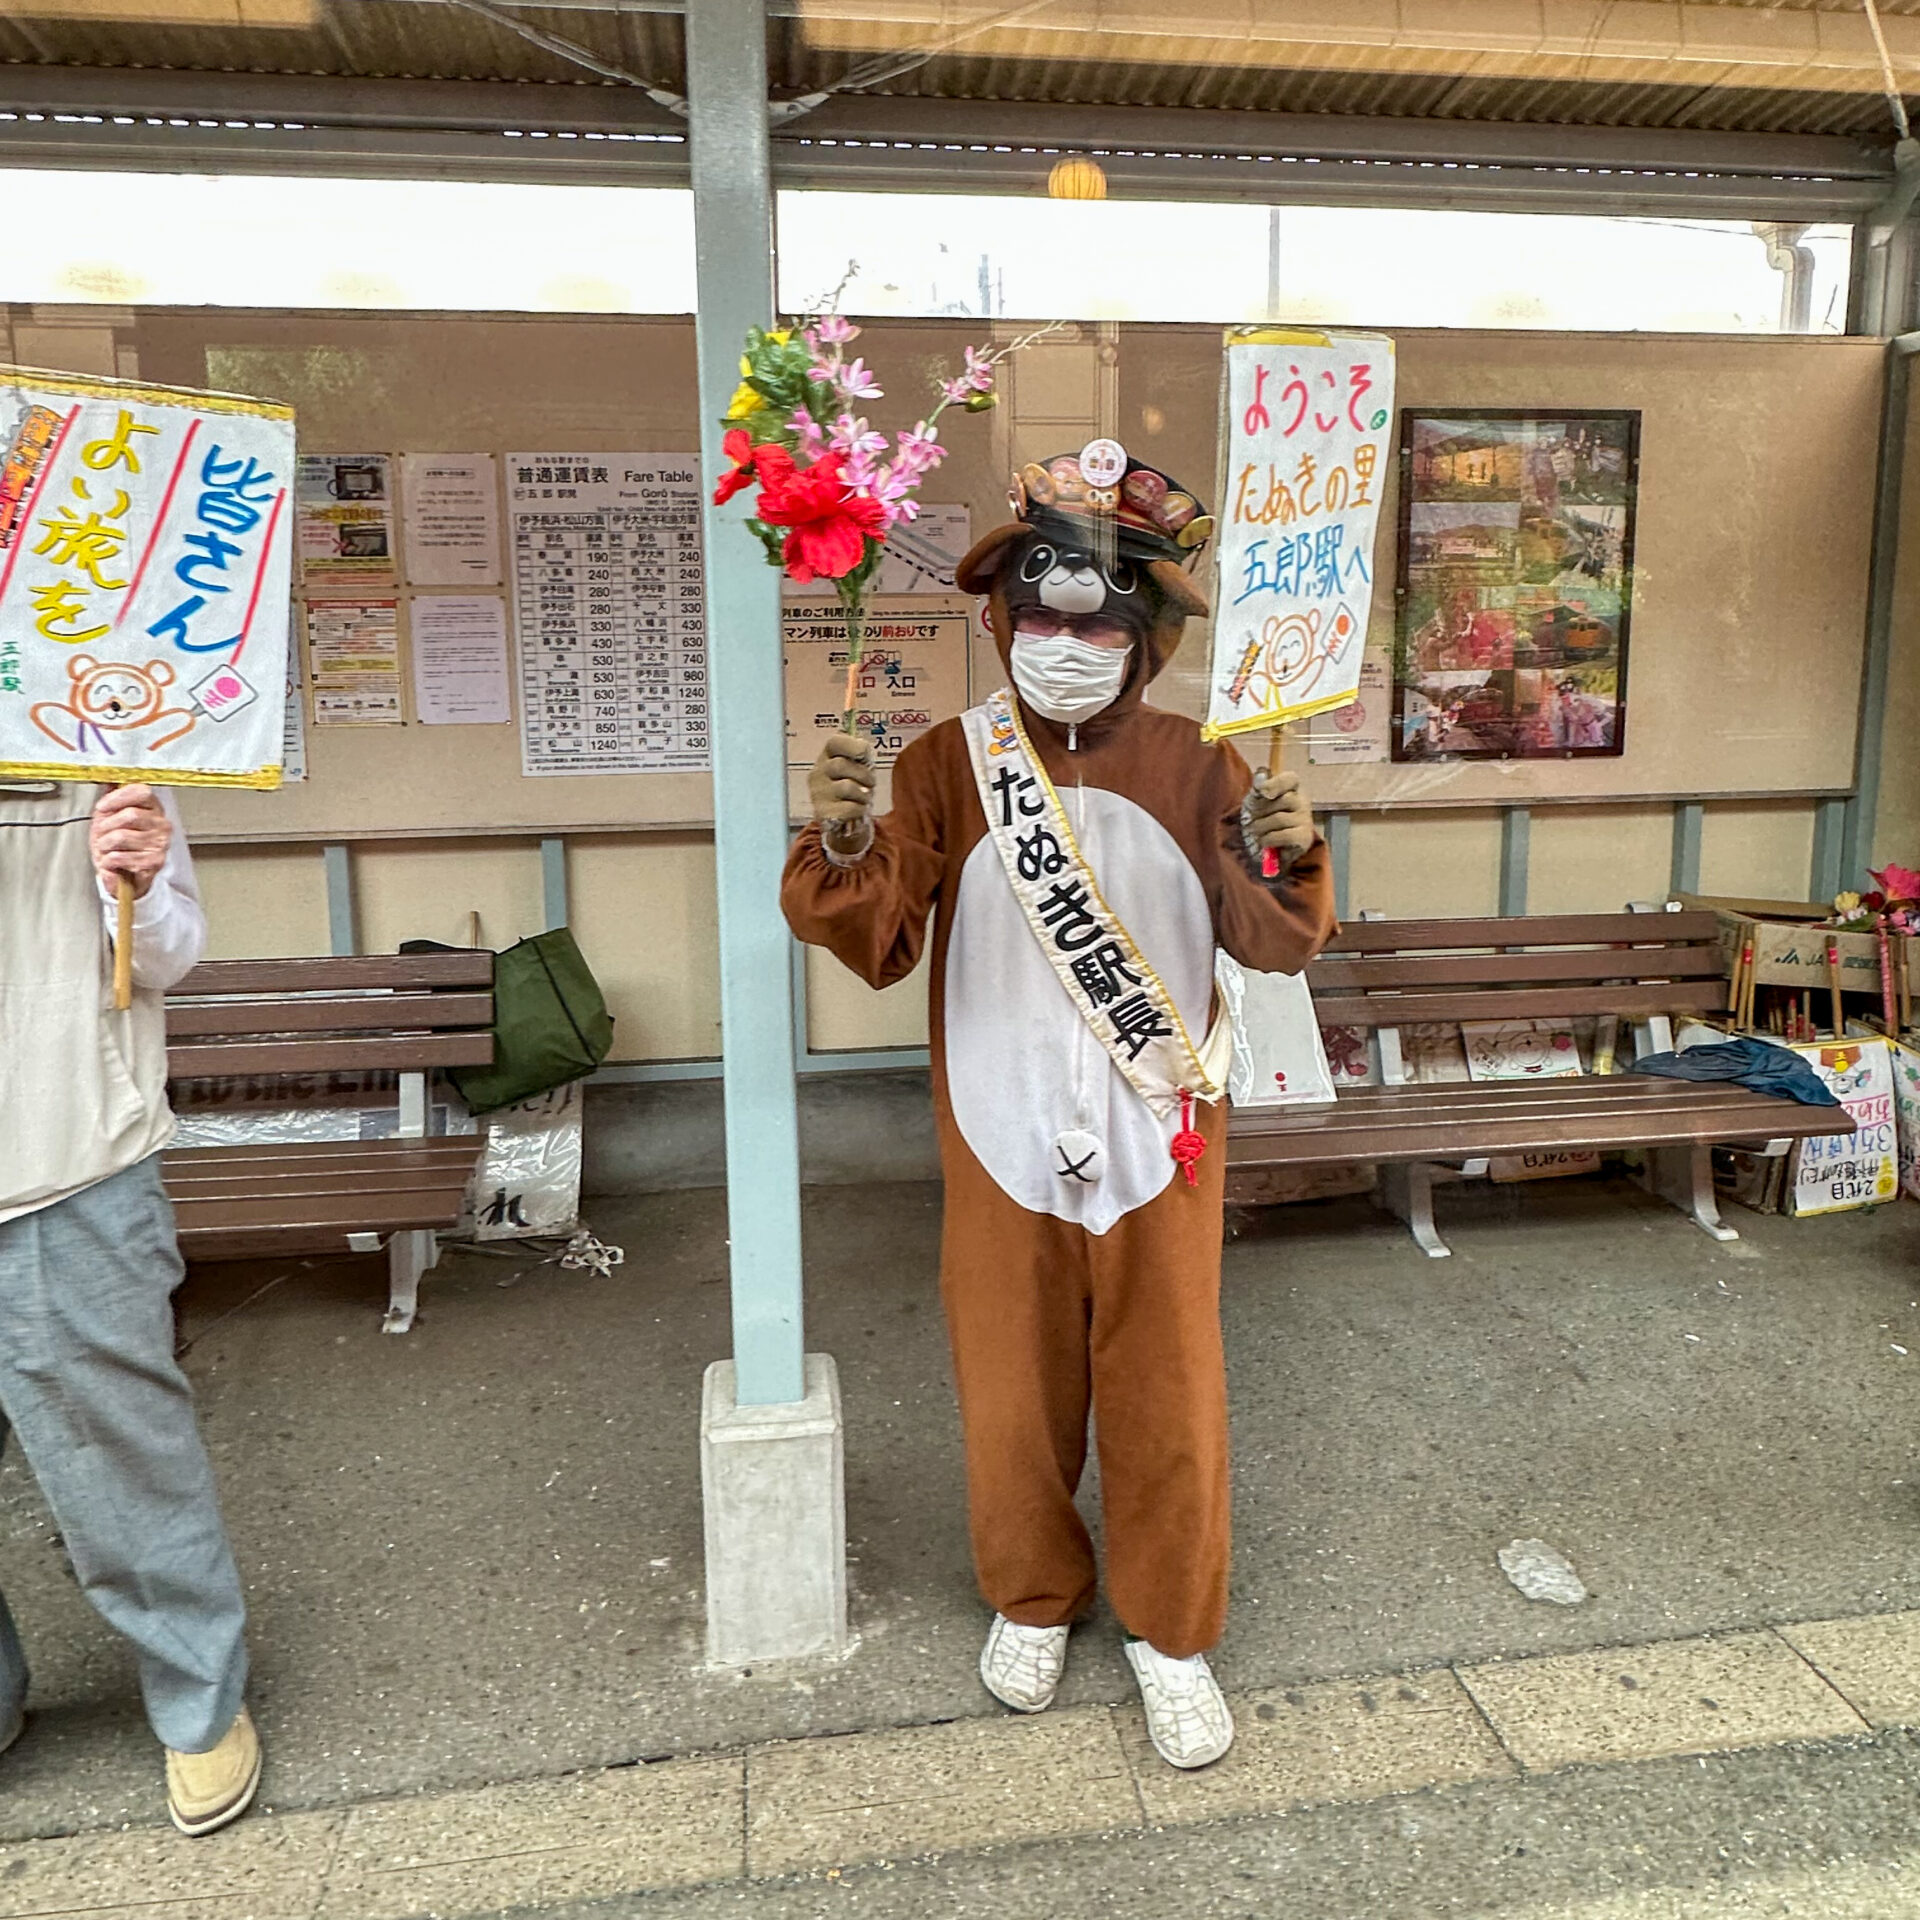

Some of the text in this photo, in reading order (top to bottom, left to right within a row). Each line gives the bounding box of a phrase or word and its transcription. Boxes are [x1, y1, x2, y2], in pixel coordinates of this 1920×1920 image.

[517, 467, 608, 483] 普通運賃表
[624, 470, 694, 482] Fare Table
[1234, 443, 1377, 525] たぬきの里
[29, 409, 160, 644] よい旅を
[147, 444, 275, 653] 皆さん
[588, 552, 608, 563] 190
[679, 552, 700, 562] 240
[1234, 523, 1370, 606] 五郎駅へ
[588, 569, 609, 580] 240
[680, 568, 700, 579] 240
[680, 586, 701, 596] 280
[681, 603, 701, 613] 330
[591, 621, 612, 632] 330
[681, 620, 702, 630] 430
[592, 638, 612, 648] 430
[683, 637, 703, 647] 630
[592, 655, 613, 665] 530
[684, 654, 704, 664] 740
[594, 672, 614, 683] 530
[887, 676, 915, 689] 入口
[594, 689, 615, 700] 630
[679, 688, 705, 698] 1240
[595, 706, 616, 716] 740
[685, 705, 705, 715] 280
[596, 723, 616, 733] 850
[686, 721, 706, 731] 330
[591, 739, 617, 750] 1240
[687, 738, 706, 749] 430
[874, 736, 902, 749] 入口
[992, 766, 1172, 1061] たぬき駅長
[1832, 1181, 1874, 1200] 2代目
